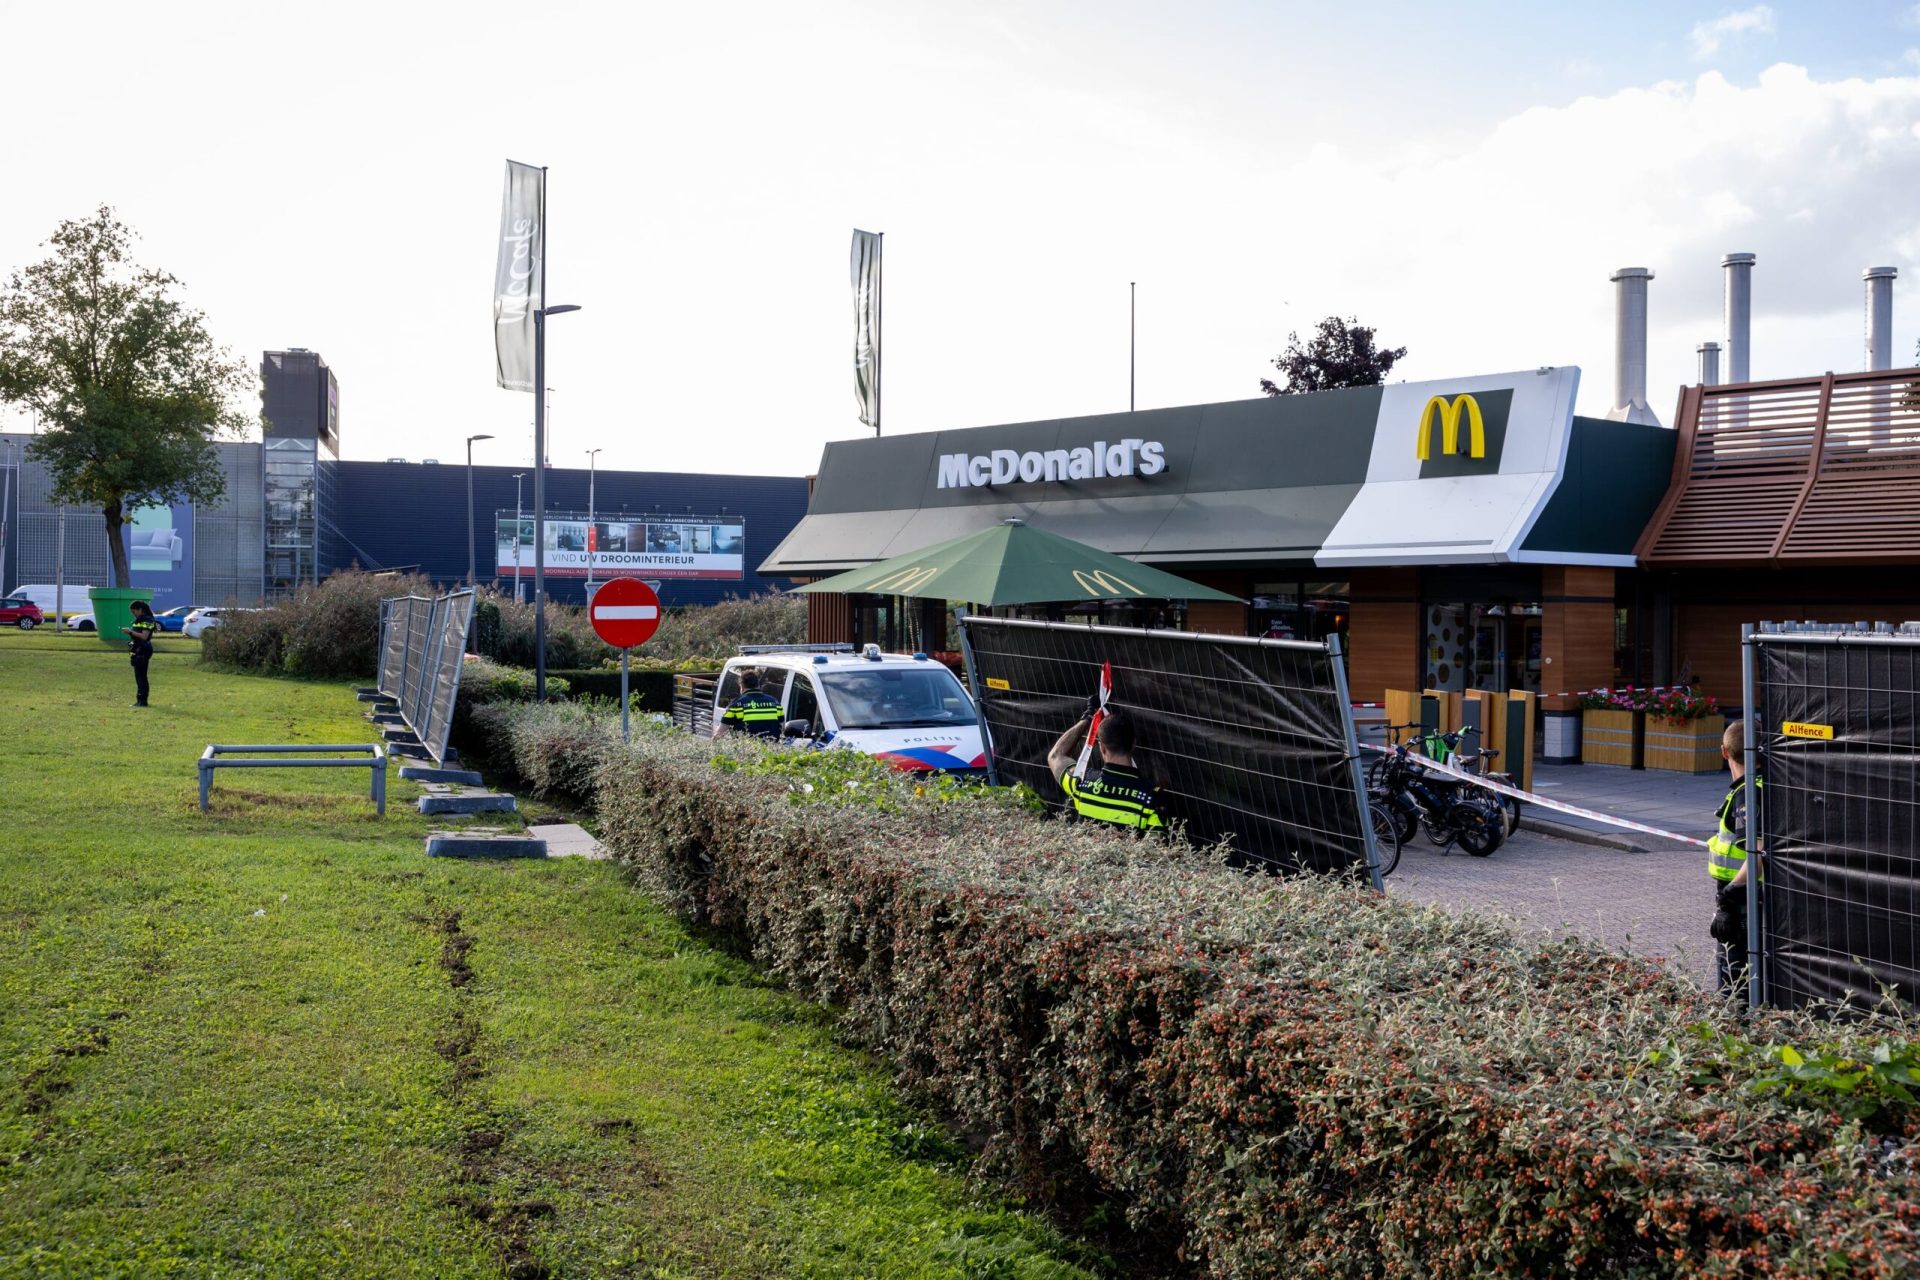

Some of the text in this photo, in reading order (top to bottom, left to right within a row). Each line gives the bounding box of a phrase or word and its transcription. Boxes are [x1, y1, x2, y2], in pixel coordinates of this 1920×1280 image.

[937, 438, 1165, 489] McDonald's
[552, 553, 576, 562] VIND
[601, 555, 694, 564] DROOMINTERIEUR
[1789, 725, 1824, 737] Allfence
[1088, 780, 1138, 798] POLITIE
